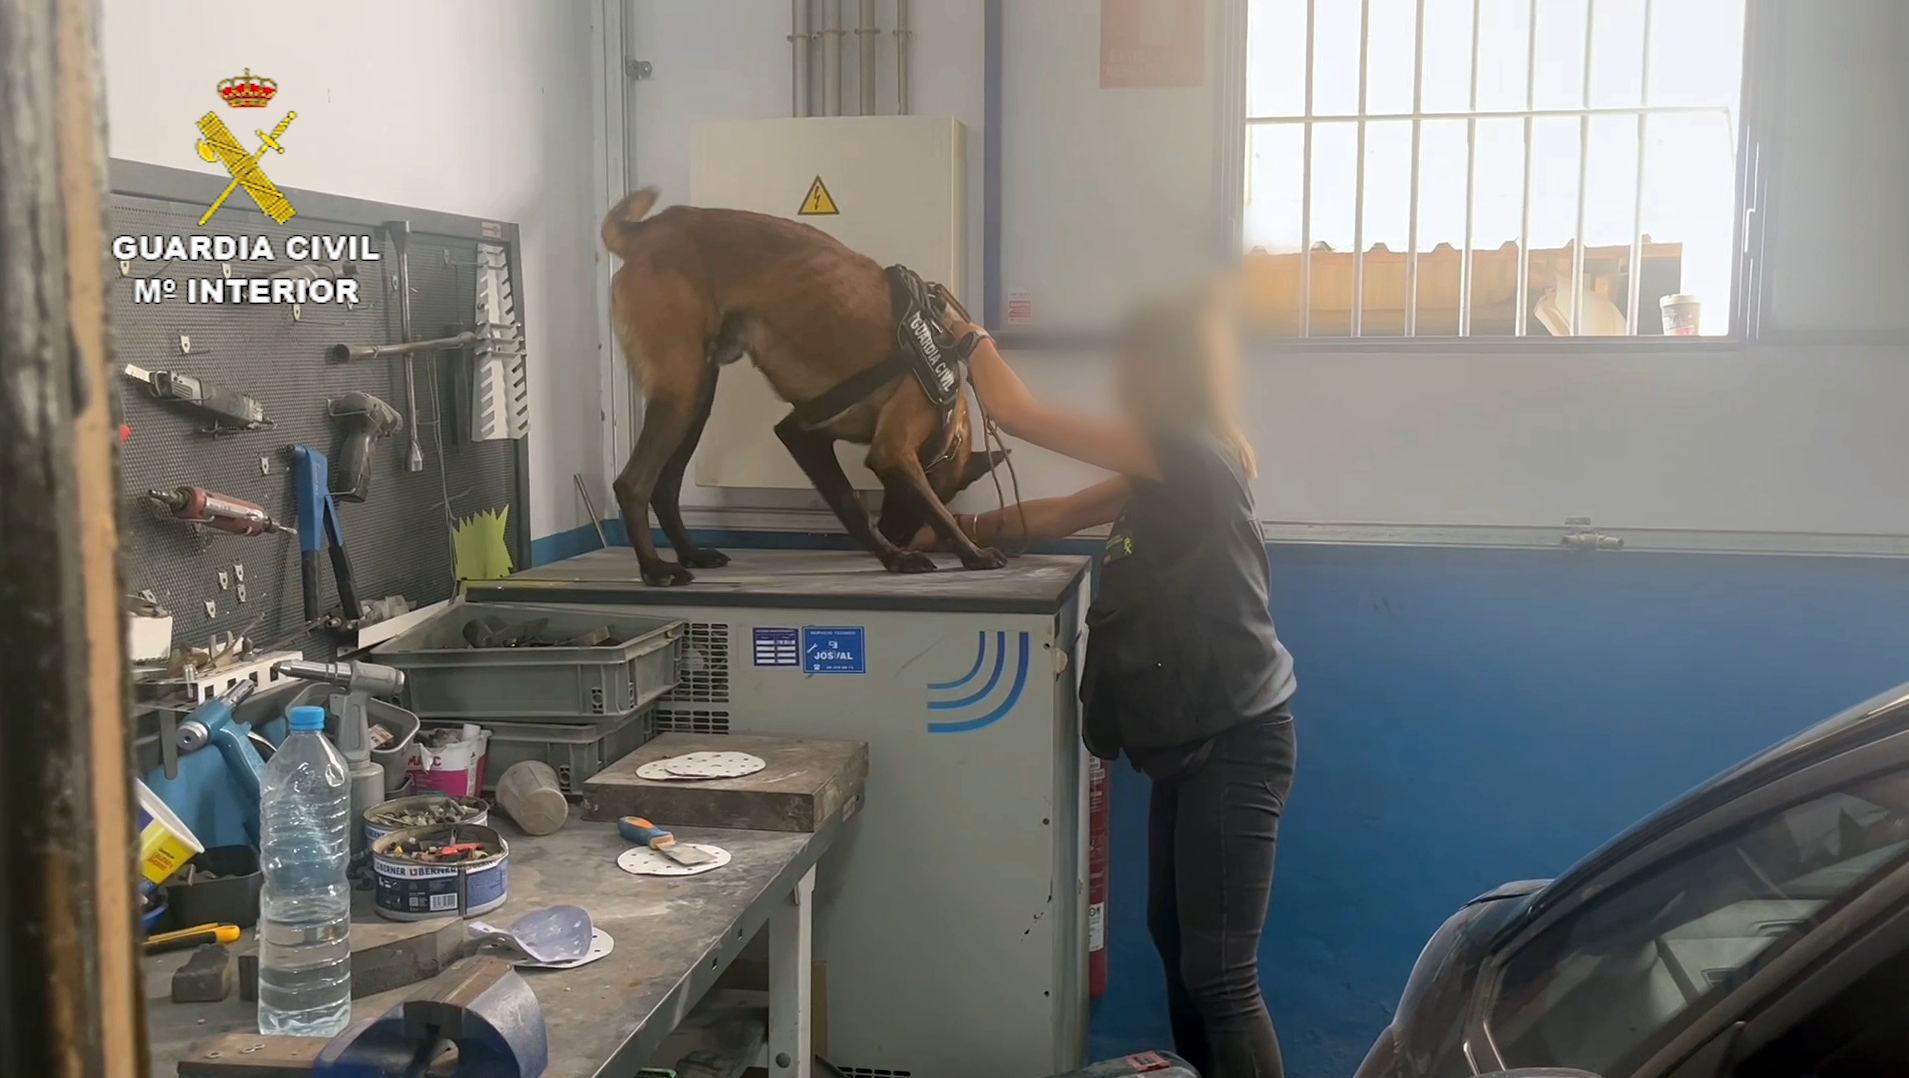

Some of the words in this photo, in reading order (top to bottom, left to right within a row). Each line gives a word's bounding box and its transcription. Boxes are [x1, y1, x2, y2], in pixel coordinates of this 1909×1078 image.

[910, 318, 942, 366] GUARDIA
[935, 362, 955, 392] CIVIL
[379, 861, 406, 876] BERNER
